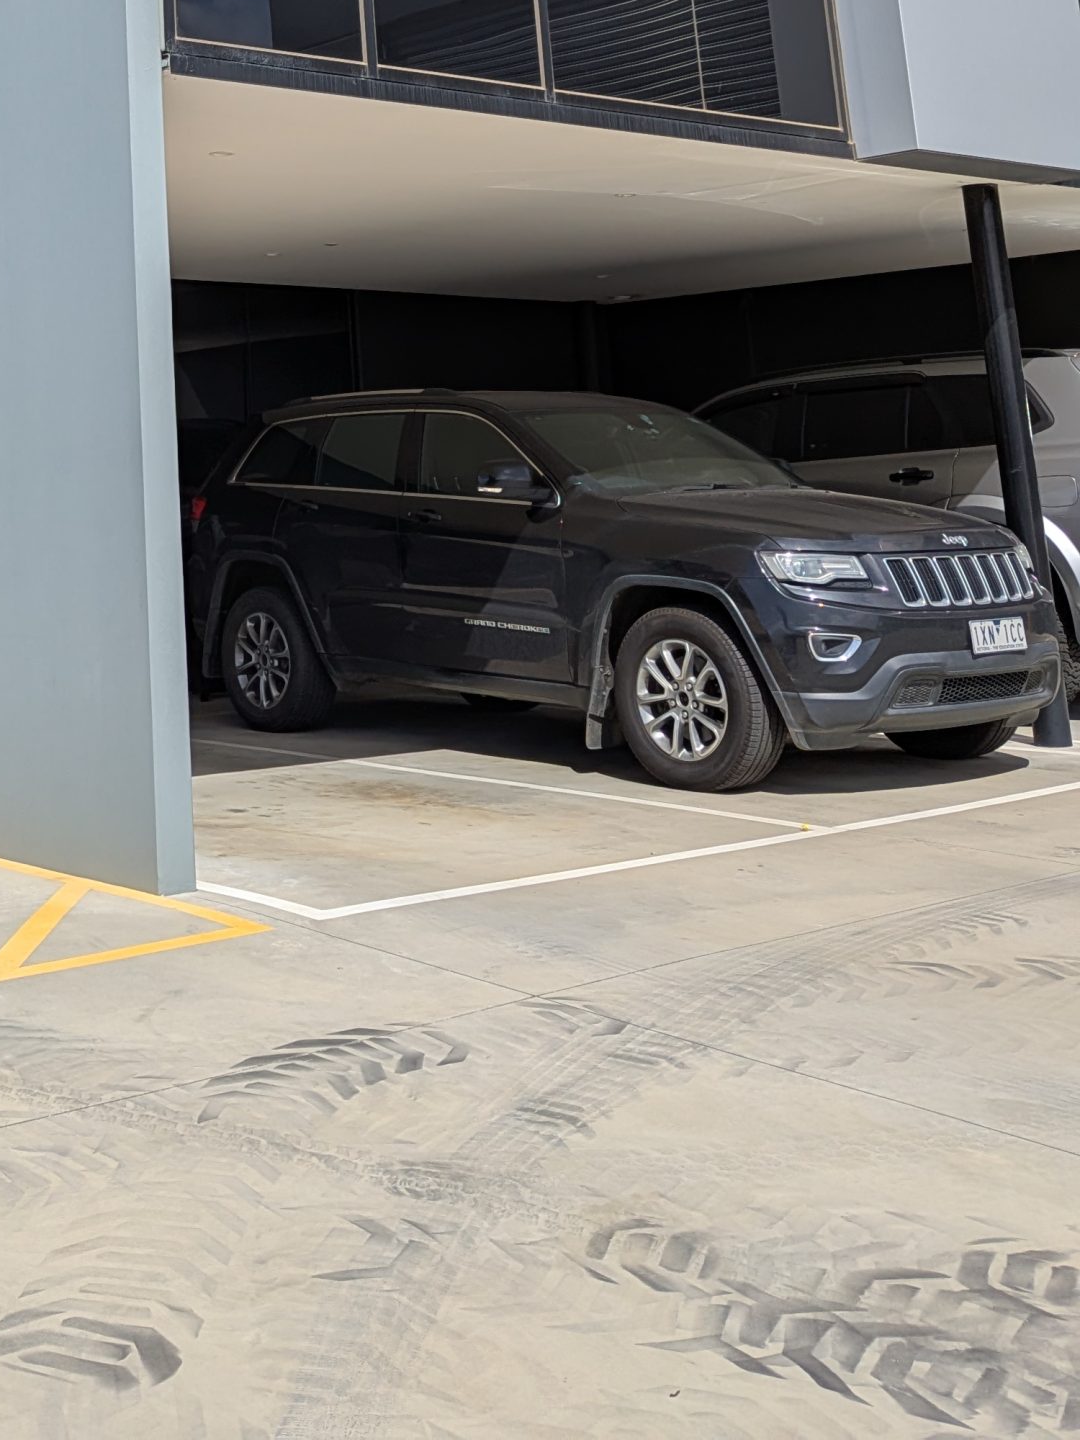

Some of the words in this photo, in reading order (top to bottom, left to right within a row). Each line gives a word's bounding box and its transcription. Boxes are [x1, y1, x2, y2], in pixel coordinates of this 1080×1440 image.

[942, 533, 968, 547] Jeep
[464, 618, 496, 628] GRAND
[497, 621, 551, 634] CHEROKEE
[974, 625, 996, 646] 1XN
[1003, 623, 1024, 643] 1CC
